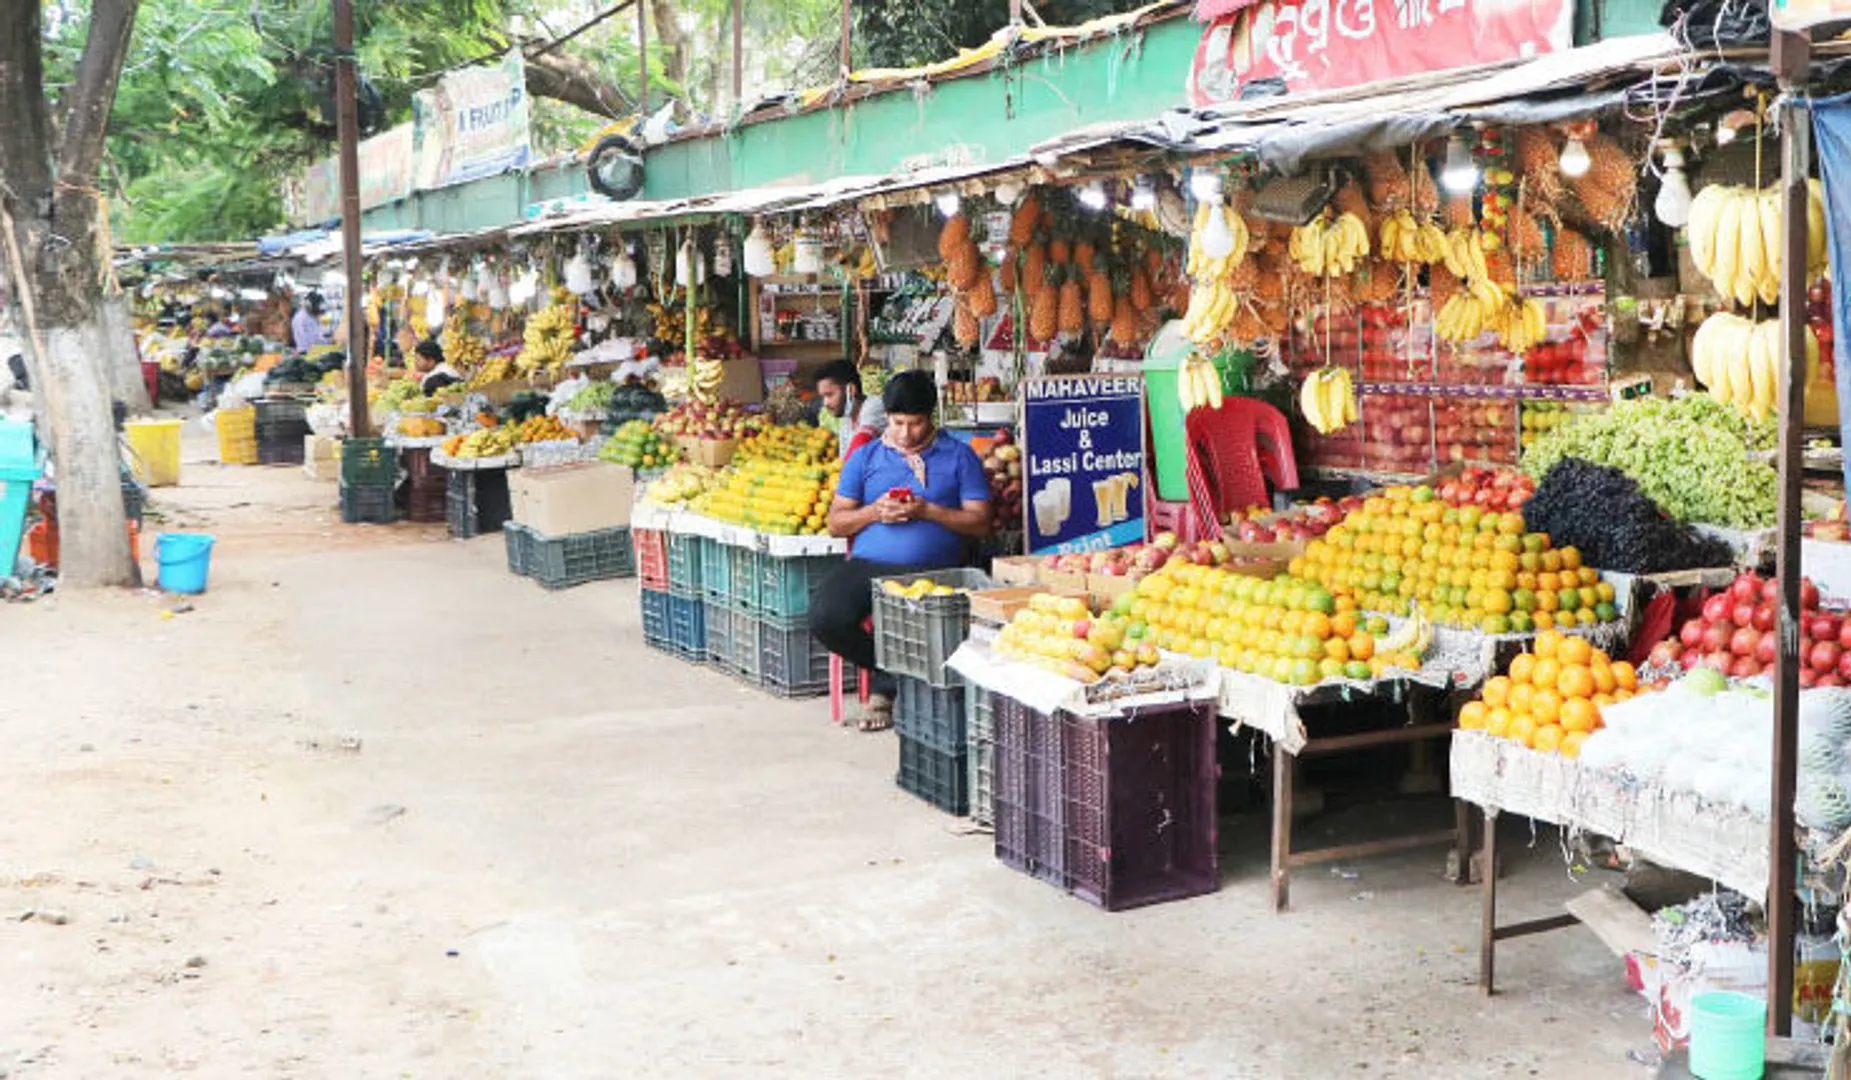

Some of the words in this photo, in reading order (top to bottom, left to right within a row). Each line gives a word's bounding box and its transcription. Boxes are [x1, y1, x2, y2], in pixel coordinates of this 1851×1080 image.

[1027, 377, 1140, 399] MAHAVEER
[1059, 407, 1109, 429] Juice
[1079, 430, 1093, 449] &
[1030, 453, 1078, 476] Lassi
[1082, 450, 1141, 471] Center
